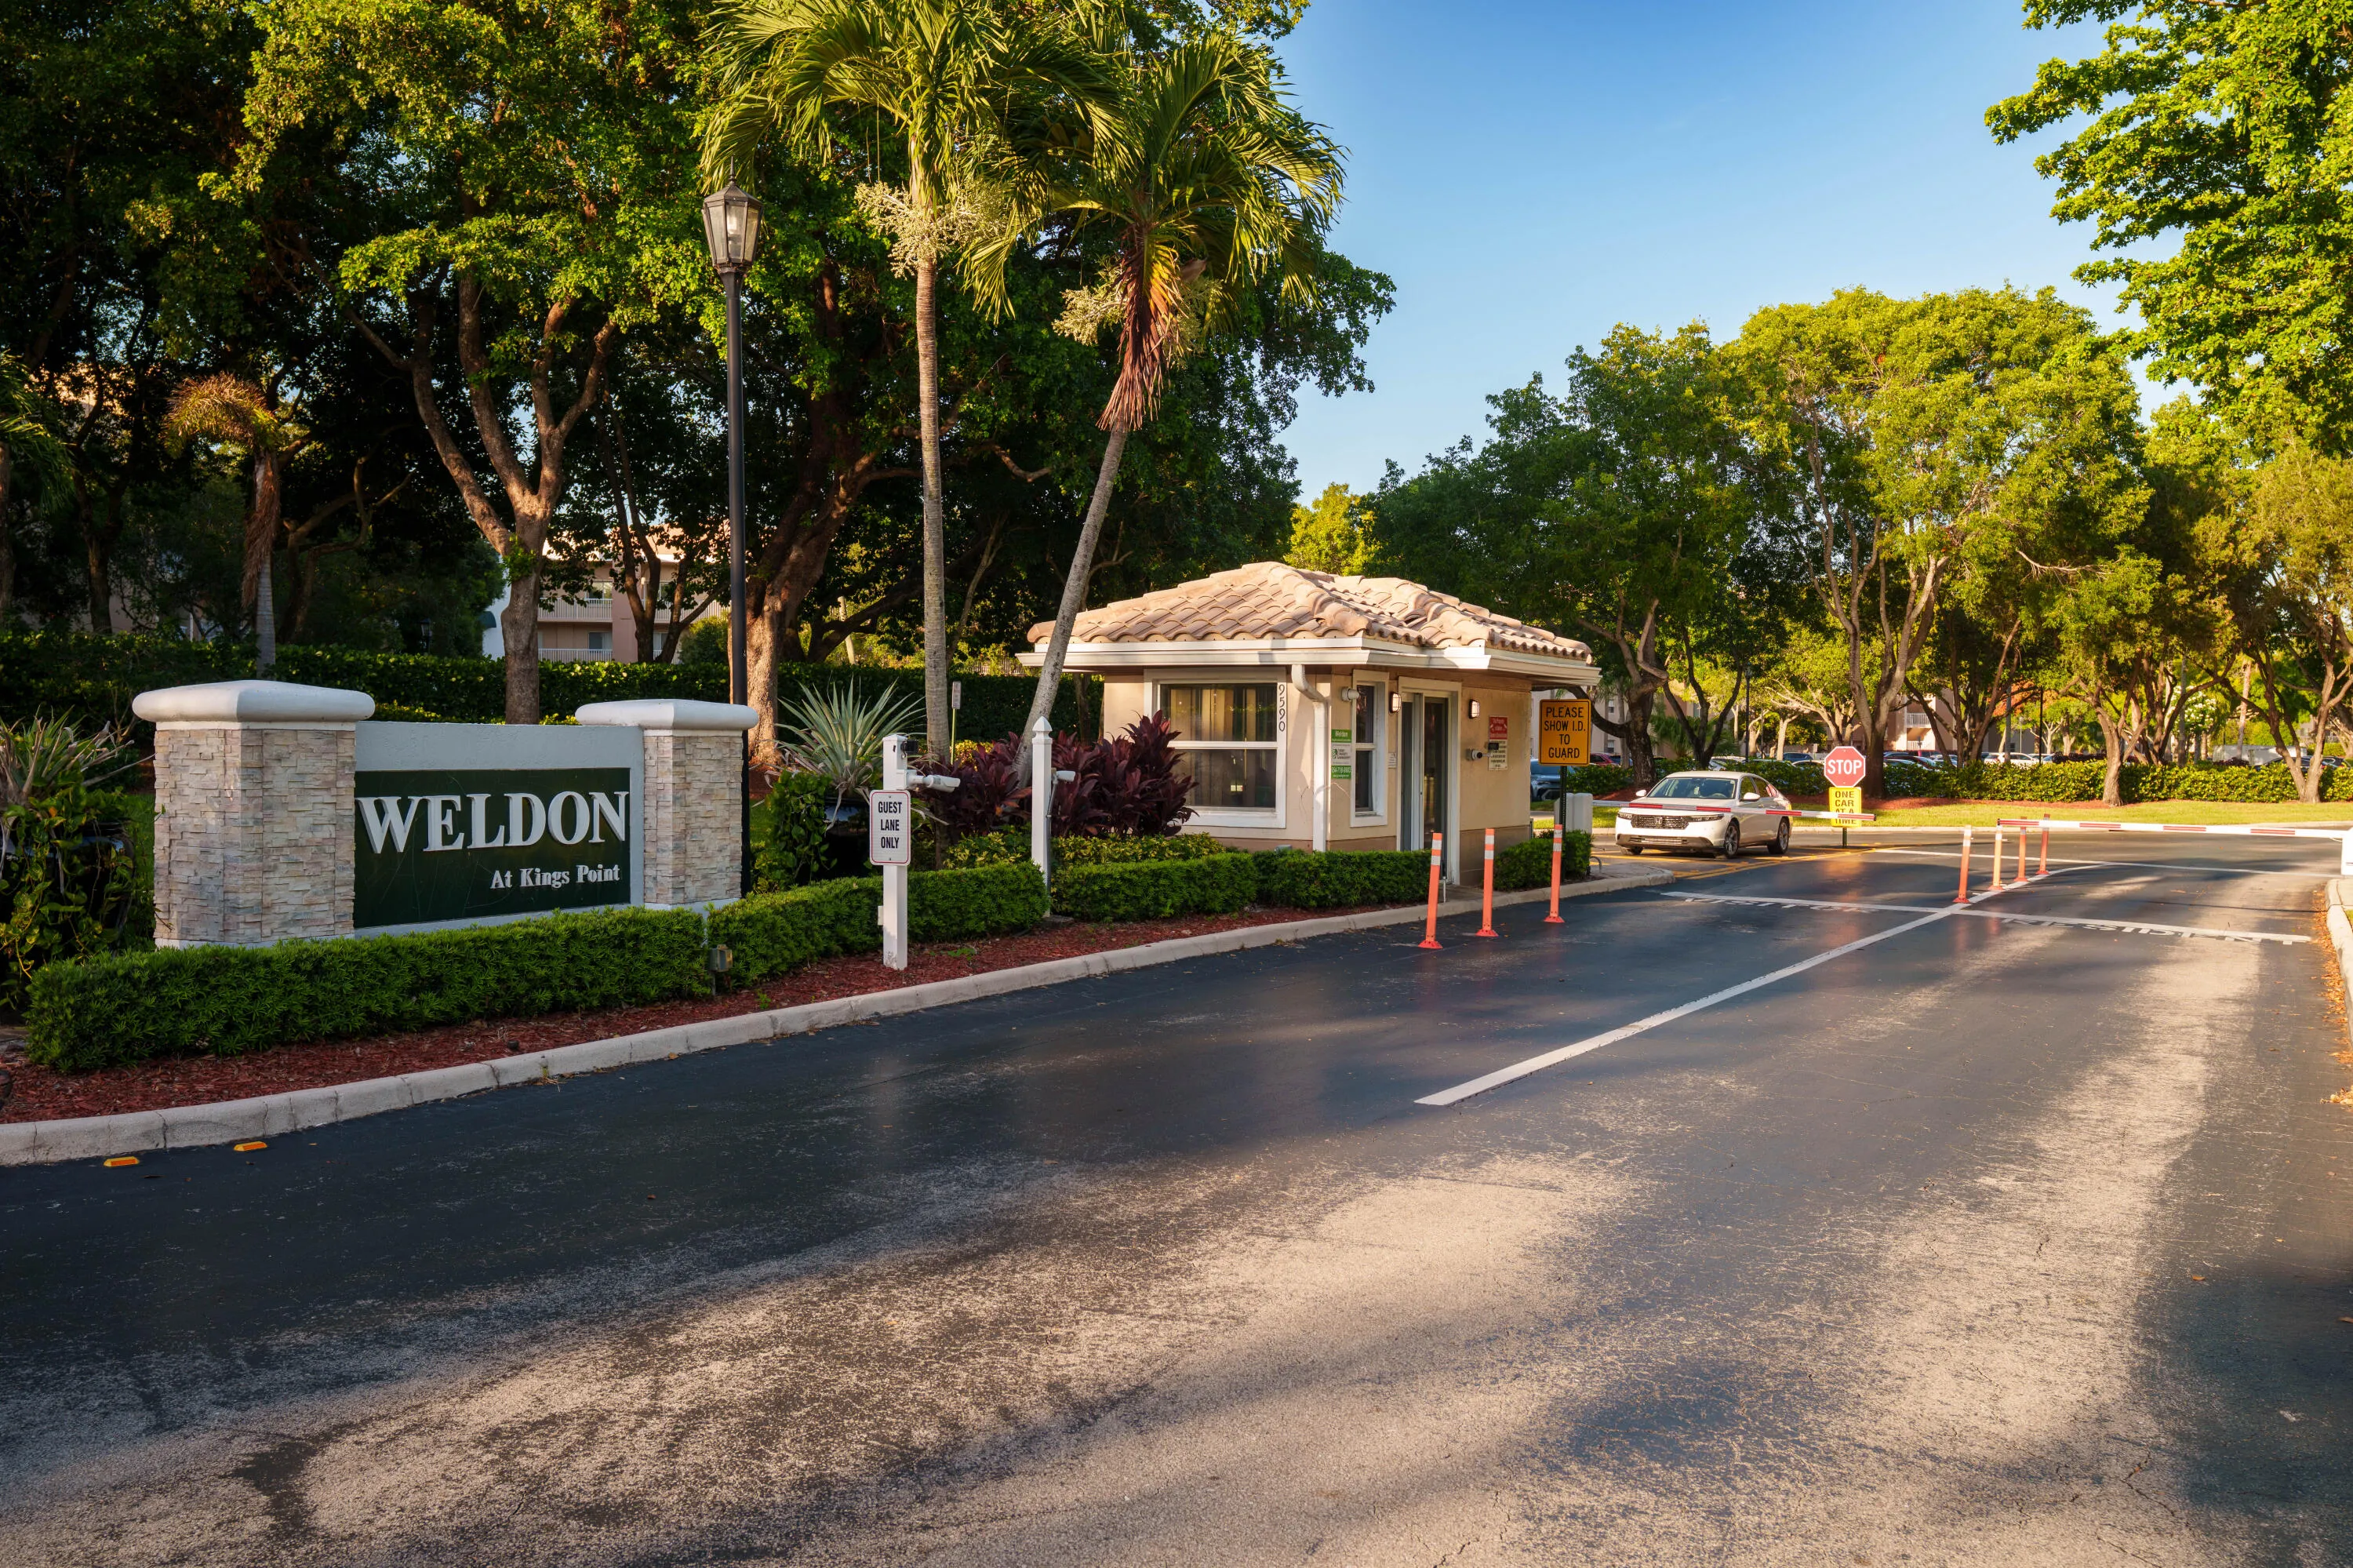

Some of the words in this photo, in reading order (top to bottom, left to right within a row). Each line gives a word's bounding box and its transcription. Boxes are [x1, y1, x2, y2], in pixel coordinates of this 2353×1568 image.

[1546, 707, 1584, 718] PLEASE
[1544, 721, 1569, 731] SHOW
[1572, 721, 1586, 732] I.D.
[1558, 734, 1570, 745] TO
[1548, 748, 1580, 759] GUARD
[1827, 759, 1862, 775] STOP
[878, 801, 902, 813] GUEST
[355, 791, 629, 854] WELDON
[880, 819, 900, 831] LANE
[881, 836, 900, 849] ONLY
[490, 869, 512, 890] At
[519, 868, 570, 890] Kings
[576, 864, 620, 883] Point
